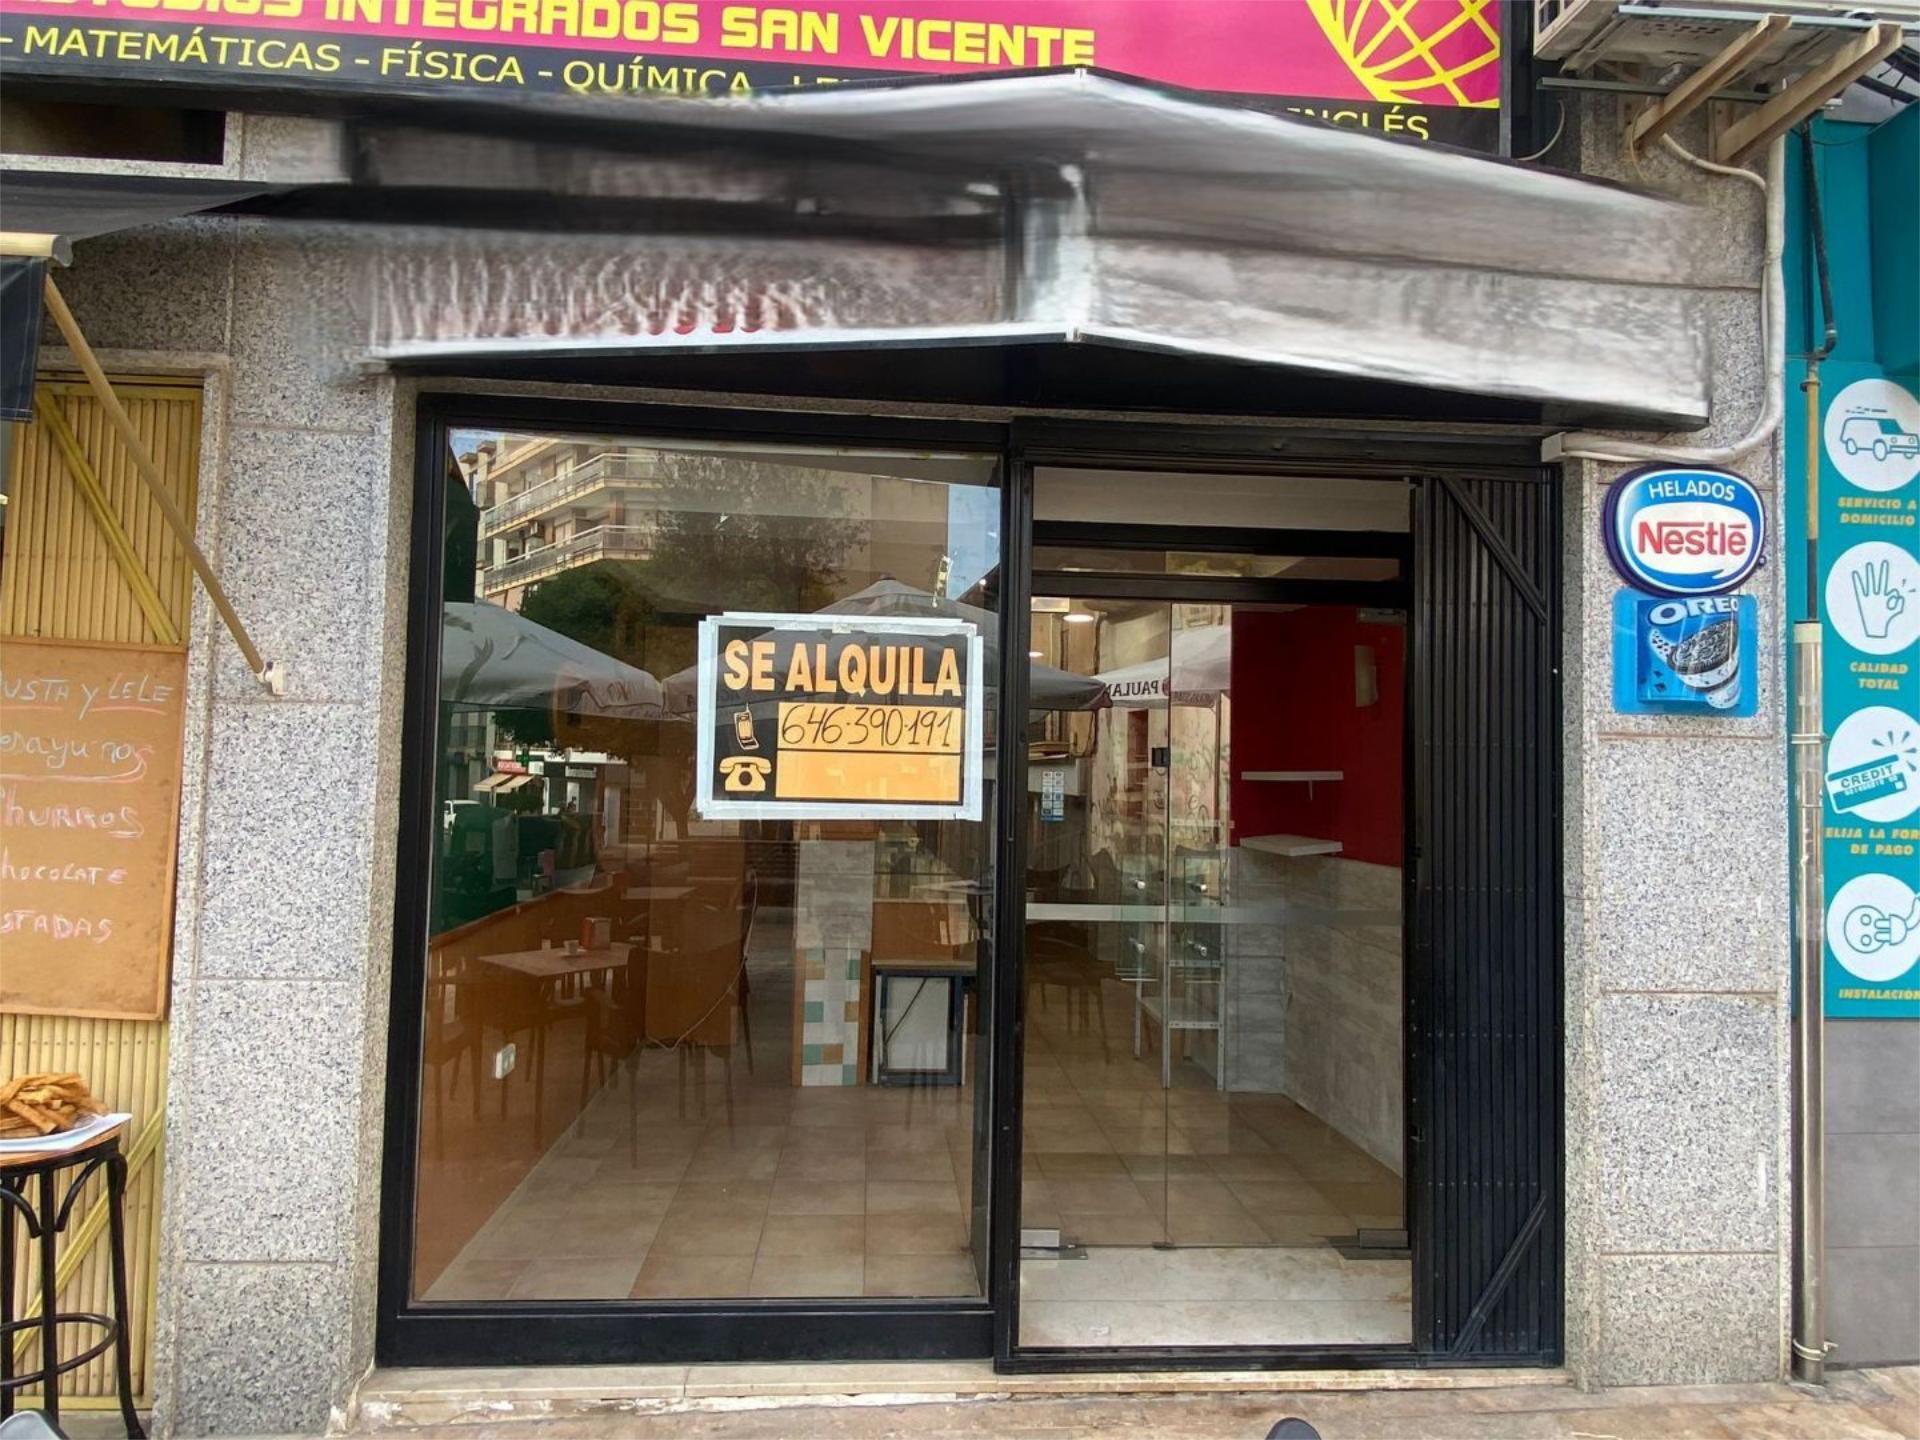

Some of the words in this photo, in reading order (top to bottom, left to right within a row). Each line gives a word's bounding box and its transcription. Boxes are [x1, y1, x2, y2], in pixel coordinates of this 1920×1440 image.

[720, 6, 838, 54] SAN
[860, 15, 1094, 66] VICENTE
[23, 25, 341, 72] MATEMÁTICAS
[381, 41, 525, 84] FÍSICA
[563, 56, 750, 95] QUÍMICA
[1648, 479, 1735, 501] HELADOS
[1838, 497, 1901, 509] SERVICIO
[1907, 500, 1917, 510] A
[1840, 513, 1915, 526] DOMICILIO
[1639, 521, 1746, 556] Nestlé
[723, 639, 776, 691] SE
[785, 642, 962, 697] ALQUILA
[1849, 662, 1909, 674] CALIDAD
[1858, 678, 1900, 690] TOTAL
[1841, 765, 1894, 788] CREDIT
[1825, 828, 1862, 838] ELIJA
[1869, 828, 1886, 838] LA
[1850, 844, 1869, 855] DE
[1876, 844, 1914, 856] PAGO
